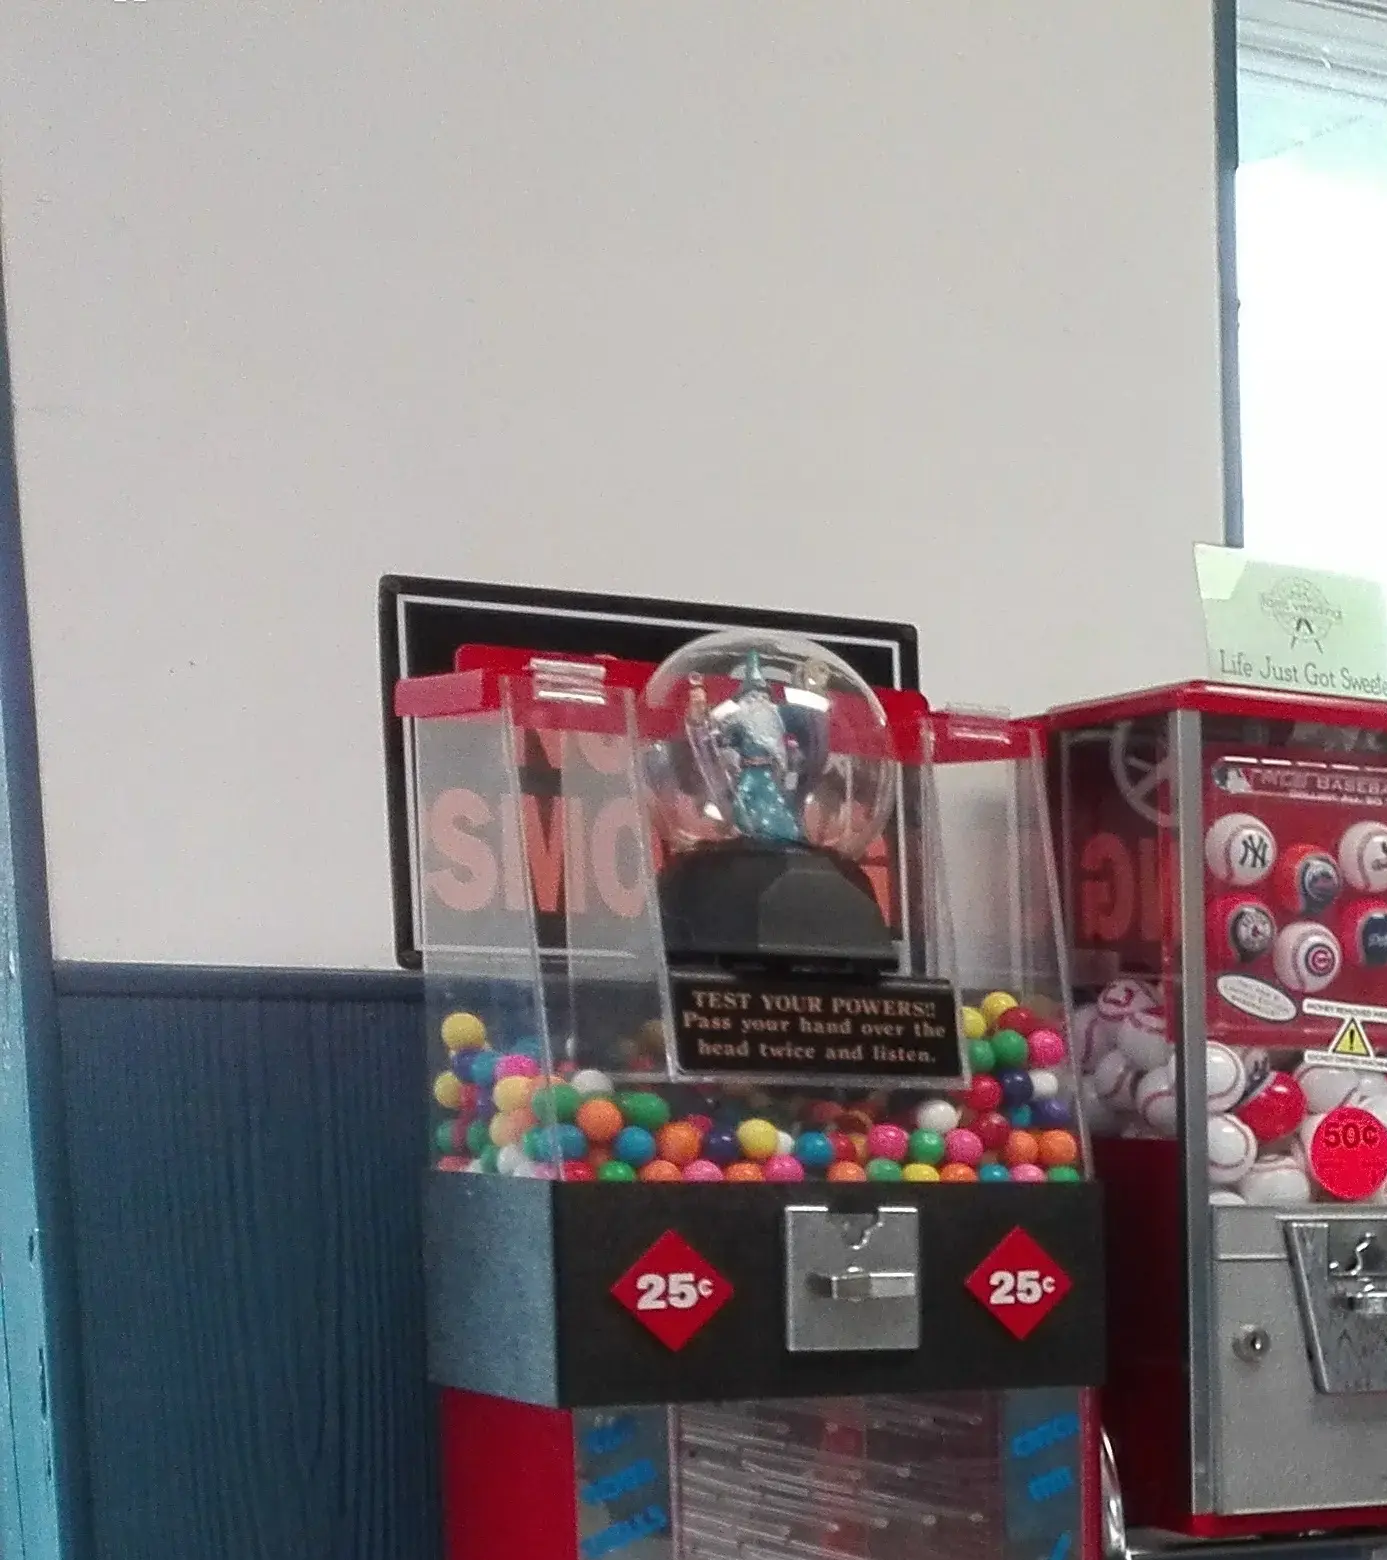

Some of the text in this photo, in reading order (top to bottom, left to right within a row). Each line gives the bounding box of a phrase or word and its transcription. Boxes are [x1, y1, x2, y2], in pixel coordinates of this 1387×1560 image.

[1219, 649, 1253, 678] Life
[1259, 655, 1300, 684] Just
[1304, 662, 1338, 689] Got
[692, 989, 751, 1010] TEST
[760, 993, 822, 1013] YOUR
[682, 1011, 946, 1038] Pass your hand over the
[697, 1039, 937, 1063] head twice and listen.
